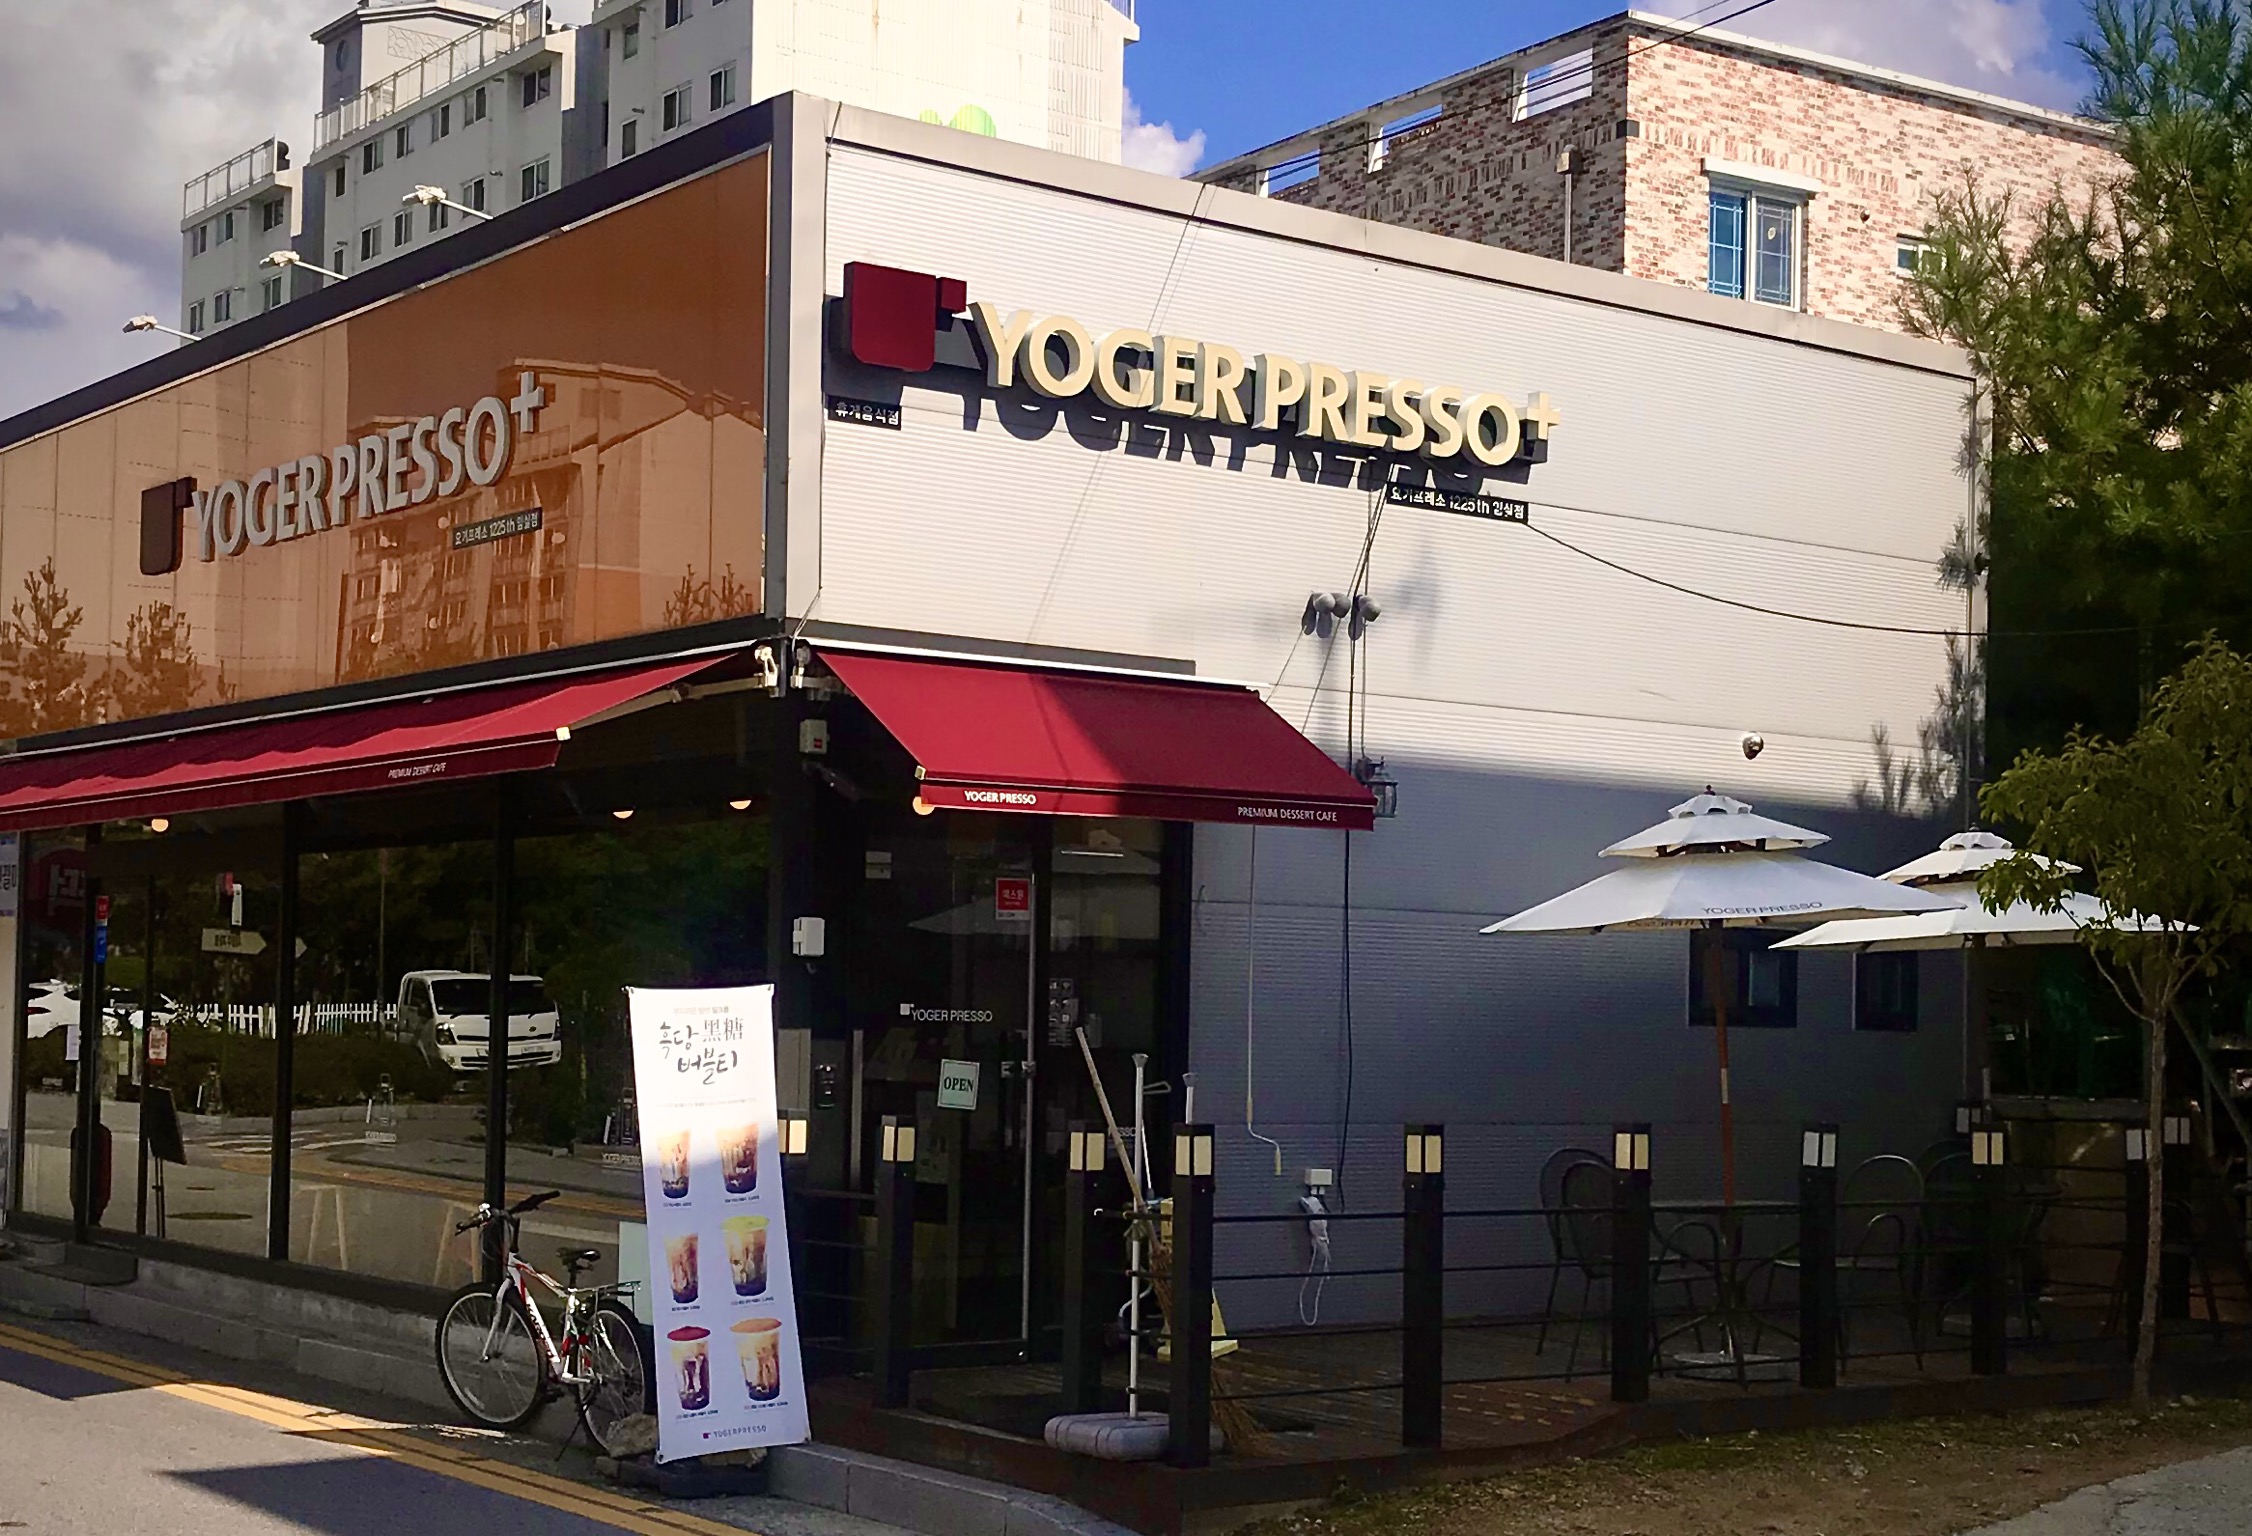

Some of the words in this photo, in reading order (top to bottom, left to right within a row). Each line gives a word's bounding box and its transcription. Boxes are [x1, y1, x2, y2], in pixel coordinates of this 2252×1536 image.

[835, 402, 899, 426] 휴게음식점
[1449, 495, 1490, 515] 1225th
[489, 517, 516, 537] 1225th
[1238, 806, 1278, 819] PREMIUM
[1280, 808, 1315, 821] DESSERT
[1316, 811, 1338, 823] CAFE
[911, 1009, 949, 1021] YOGER
[950, 1010, 993, 1022] PRESSO
[677, 1047, 738, 1085] 버블티
[943, 1076, 974, 1093] OPEN
